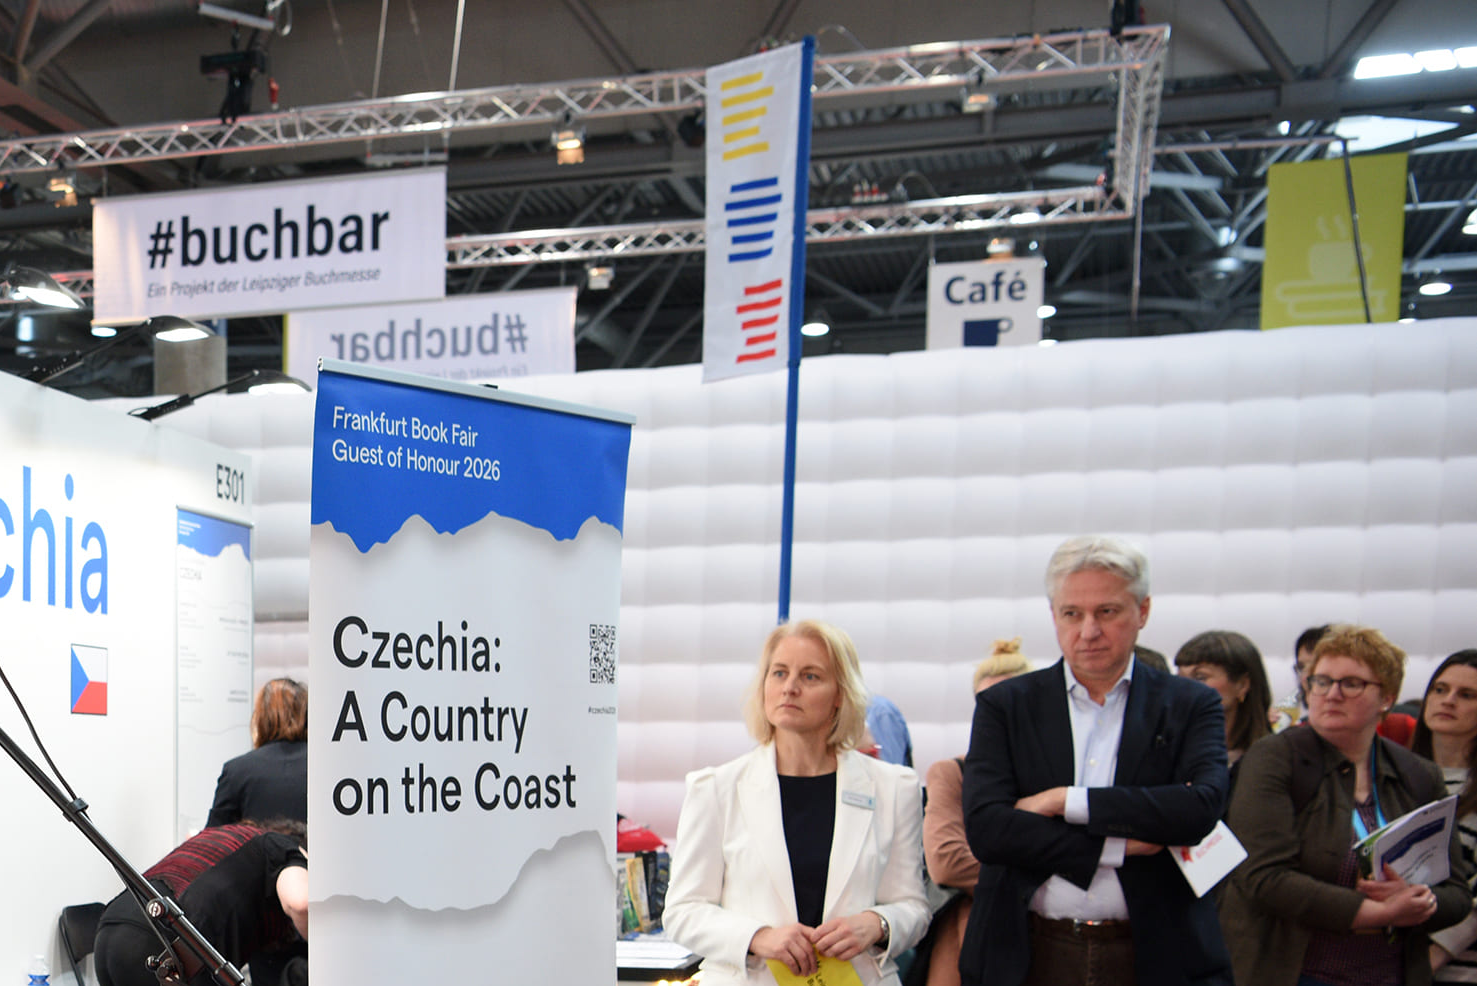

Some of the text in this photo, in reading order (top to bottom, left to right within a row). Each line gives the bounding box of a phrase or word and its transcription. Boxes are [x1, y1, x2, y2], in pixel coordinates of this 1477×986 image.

[147, 204, 390, 269] #buchbar
[147, 268, 381, 298] Ein Projekt der Leipziger Buchmesse
[944, 270, 1028, 304] Café
[332, 405, 479, 448] Frankfurt Book Fair
[332, 439, 501, 481] Guest of Honour 2026
[216, 463, 245, 505] E301
[332, 615, 501, 673] Czechia:
[331, 690, 529, 754] A Country
[332, 762, 577, 816] on the Coast
